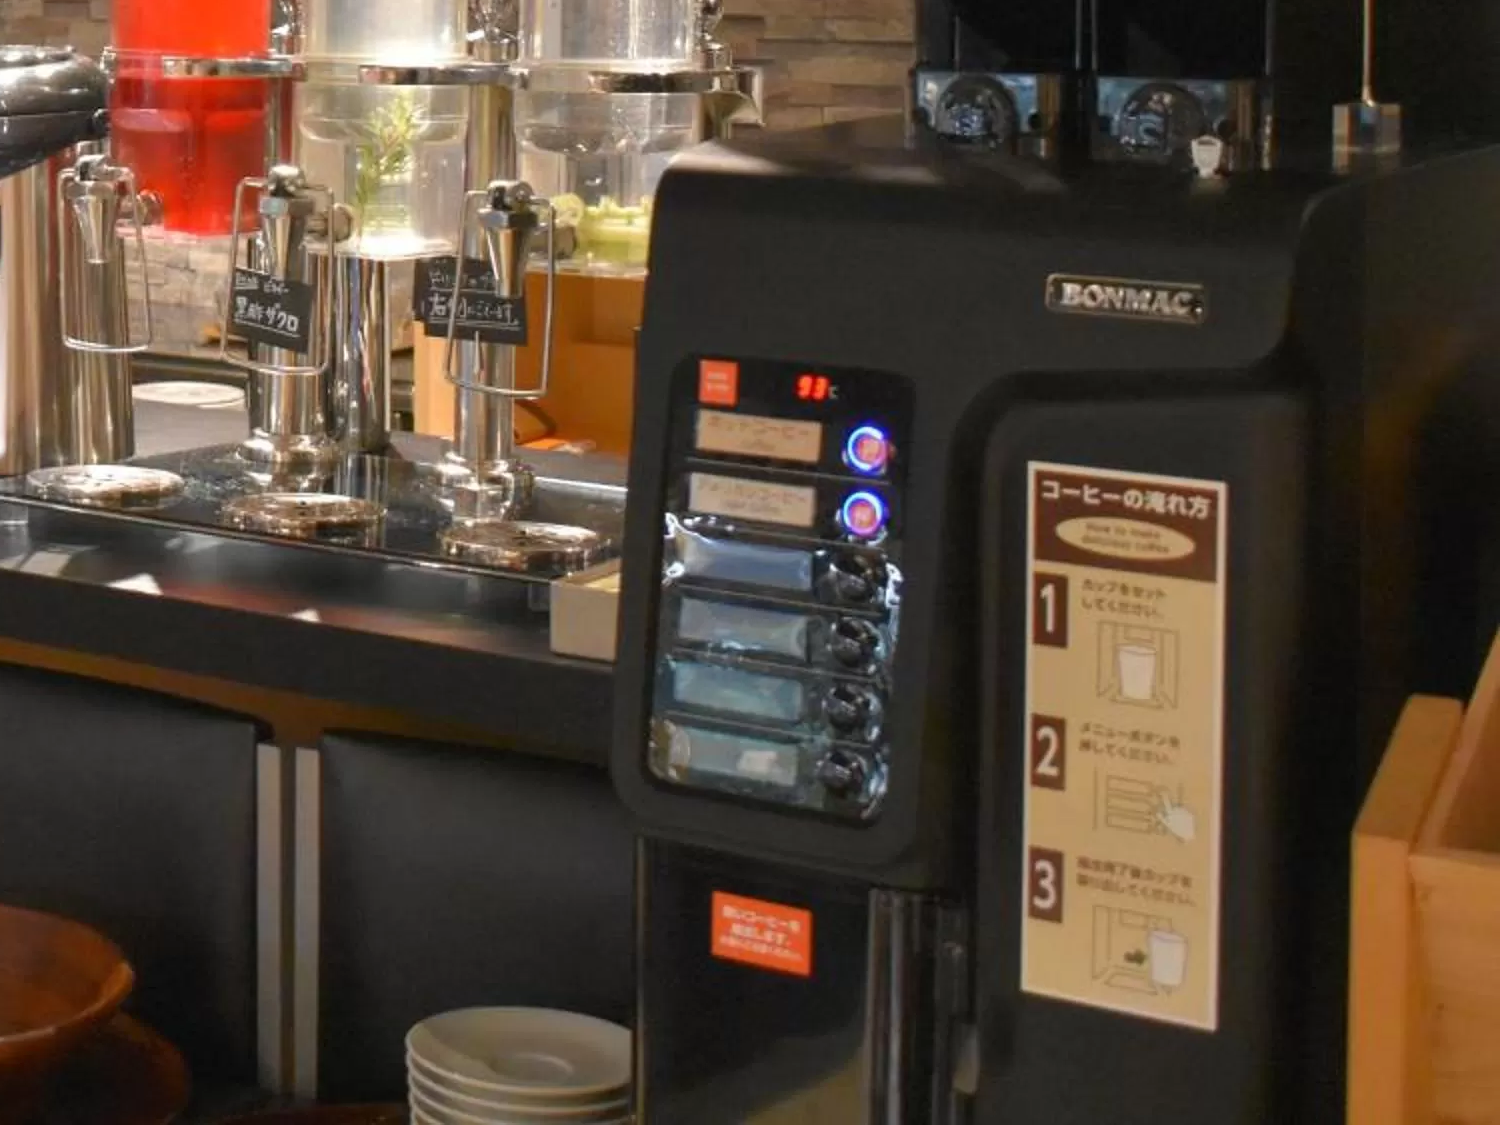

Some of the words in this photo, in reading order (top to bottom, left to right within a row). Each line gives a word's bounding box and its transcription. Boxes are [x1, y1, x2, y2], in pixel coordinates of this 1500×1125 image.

[1060, 282, 1193, 315] BONMAC
[1040, 583, 1055, 633] 1
[1035, 725, 1060, 777] 2
[1033, 859, 1056, 910] 3
